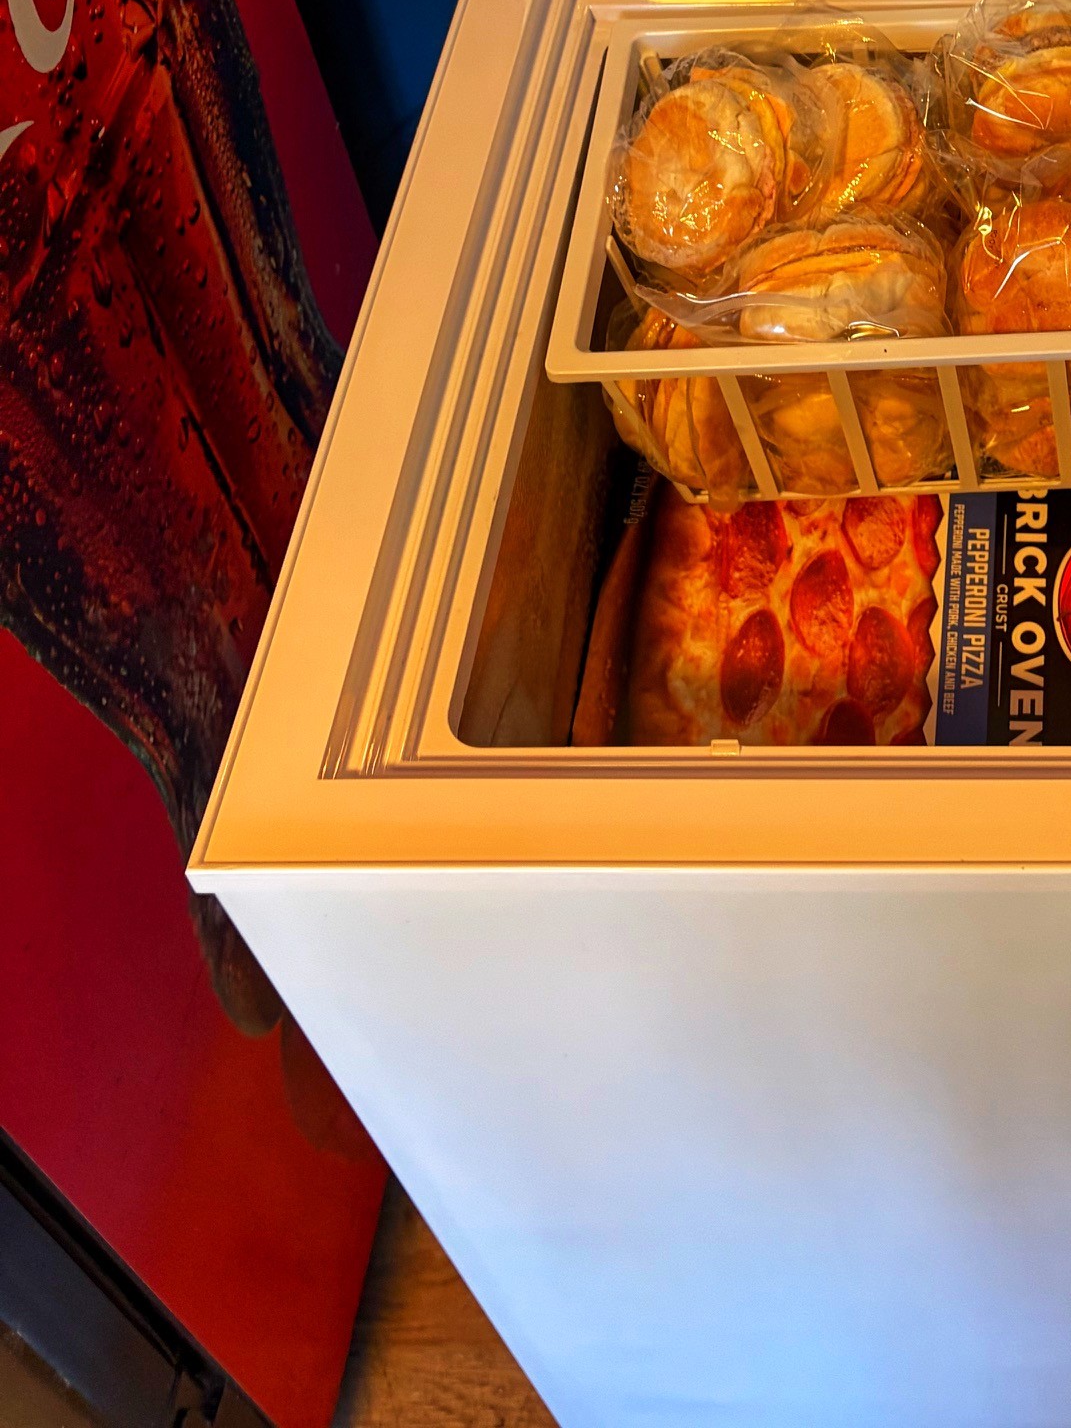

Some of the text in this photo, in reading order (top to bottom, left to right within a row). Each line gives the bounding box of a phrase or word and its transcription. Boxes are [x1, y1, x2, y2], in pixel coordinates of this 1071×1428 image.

[942, 503, 965, 716] PEPPERONI MADE WITH PORK, CHICKEN AND BEEF
[960, 528, 990, 690] PEPPERONI PIZZA
[995, 583, 1009, 633] CRUST
[1008, 621, 1046, 746] OVEN
